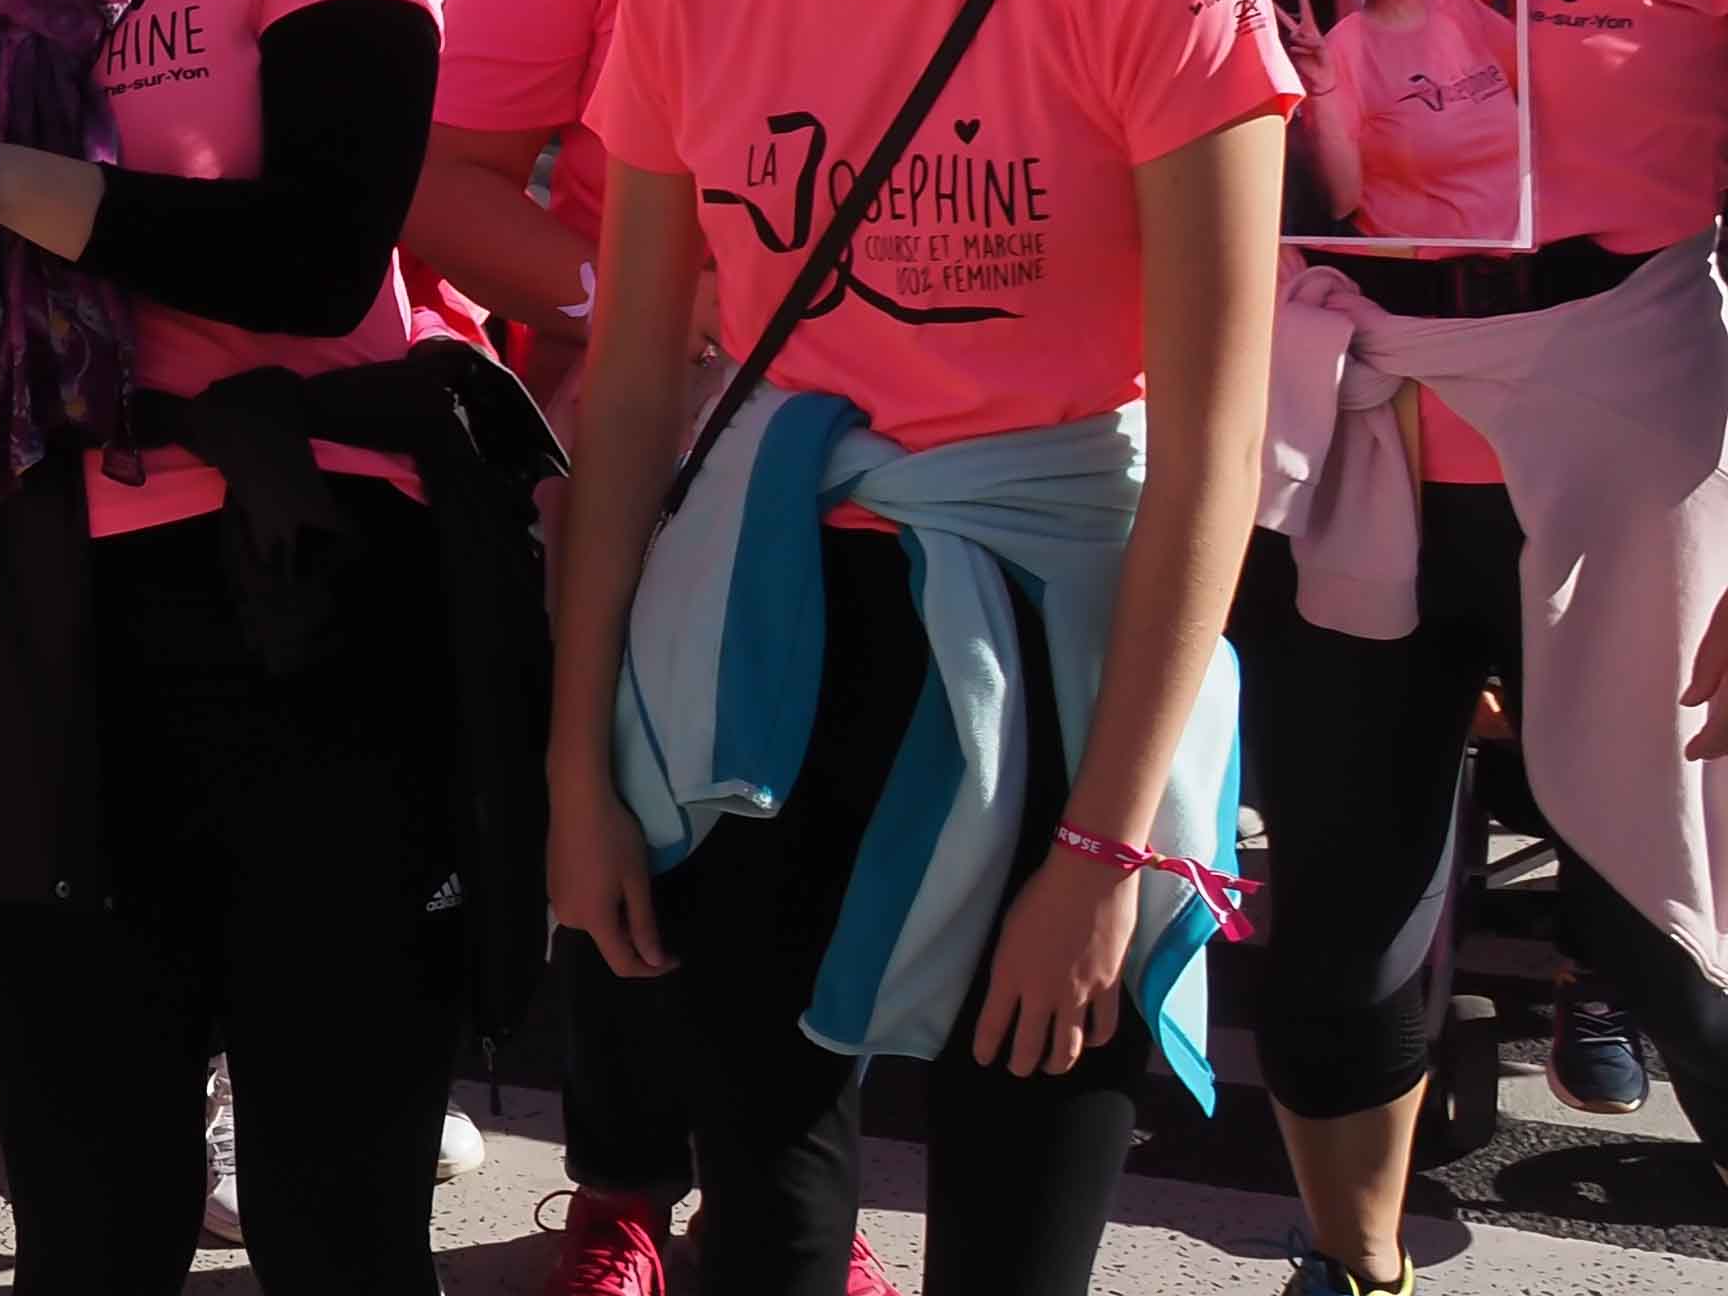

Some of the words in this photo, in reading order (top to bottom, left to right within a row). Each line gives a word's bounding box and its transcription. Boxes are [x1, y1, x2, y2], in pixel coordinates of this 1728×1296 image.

[747, 141, 778, 188] LA
[928, 235, 951, 261] ET
[964, 233, 1046, 261] MARCHE
[943, 260, 1046, 294] FÉMININE
